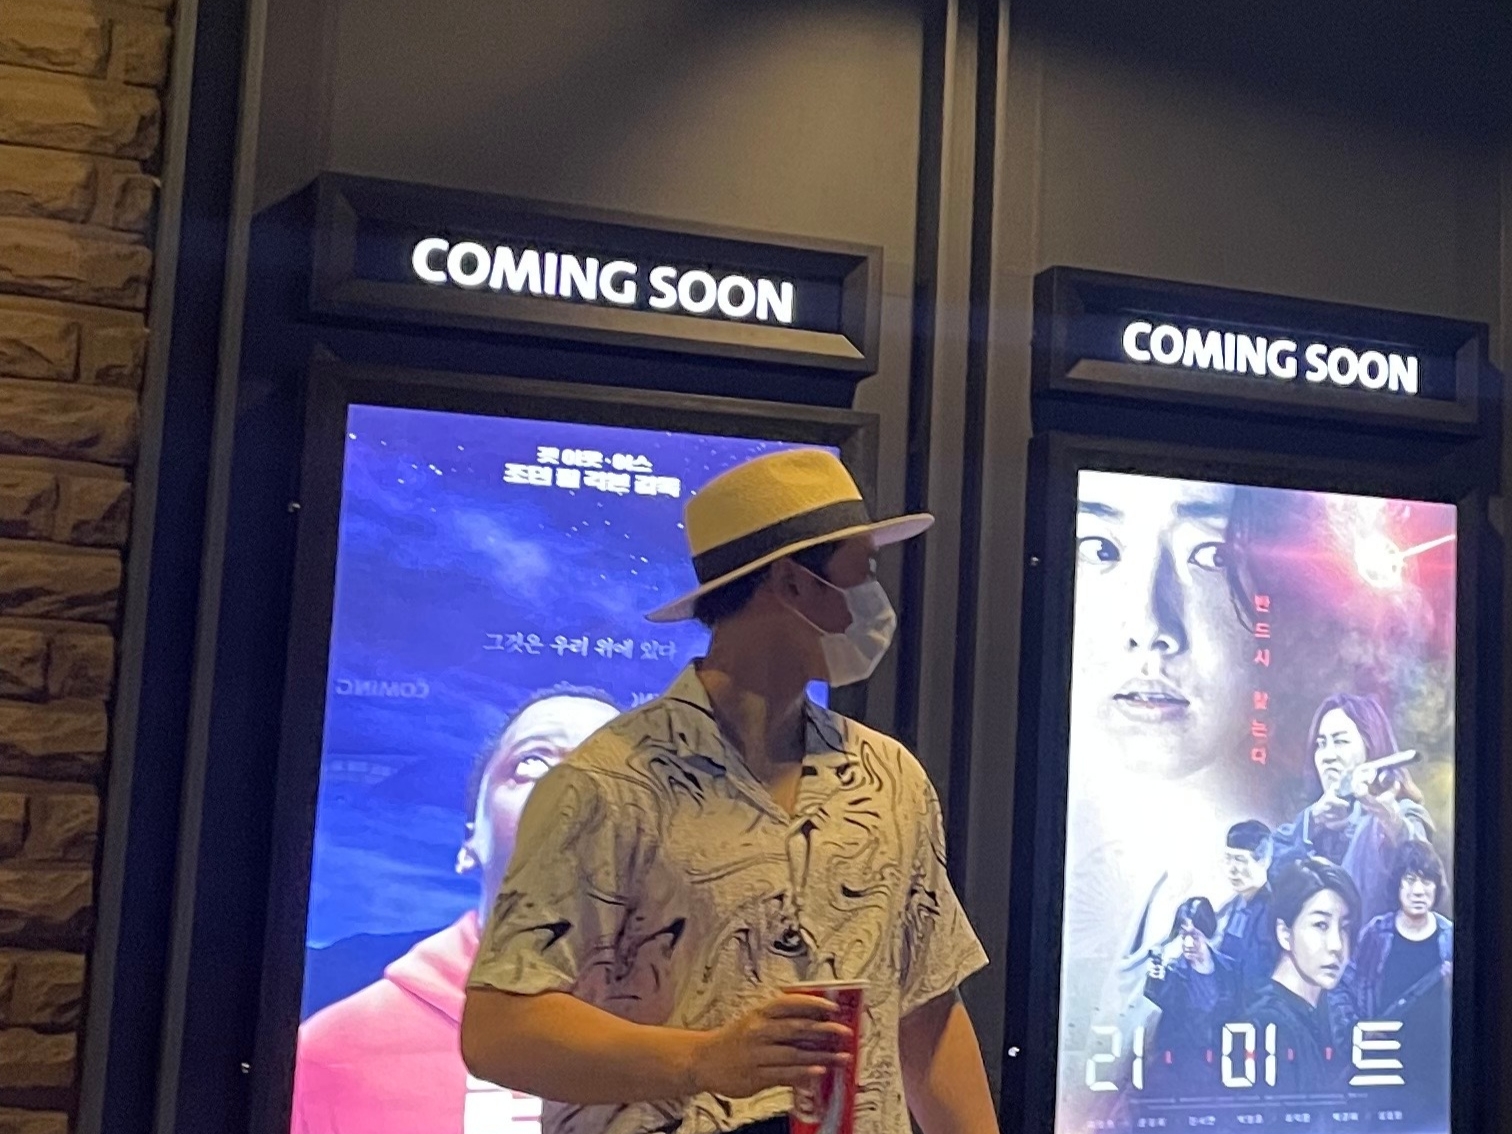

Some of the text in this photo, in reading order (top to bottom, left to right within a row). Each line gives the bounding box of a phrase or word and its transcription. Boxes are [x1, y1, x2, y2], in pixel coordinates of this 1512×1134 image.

[412, 237, 795, 323] COMING SOON
[1122, 321, 1419, 395] COMING SOON
[549, 634, 590, 658] 우리
[594, 636, 635, 660] 위에
